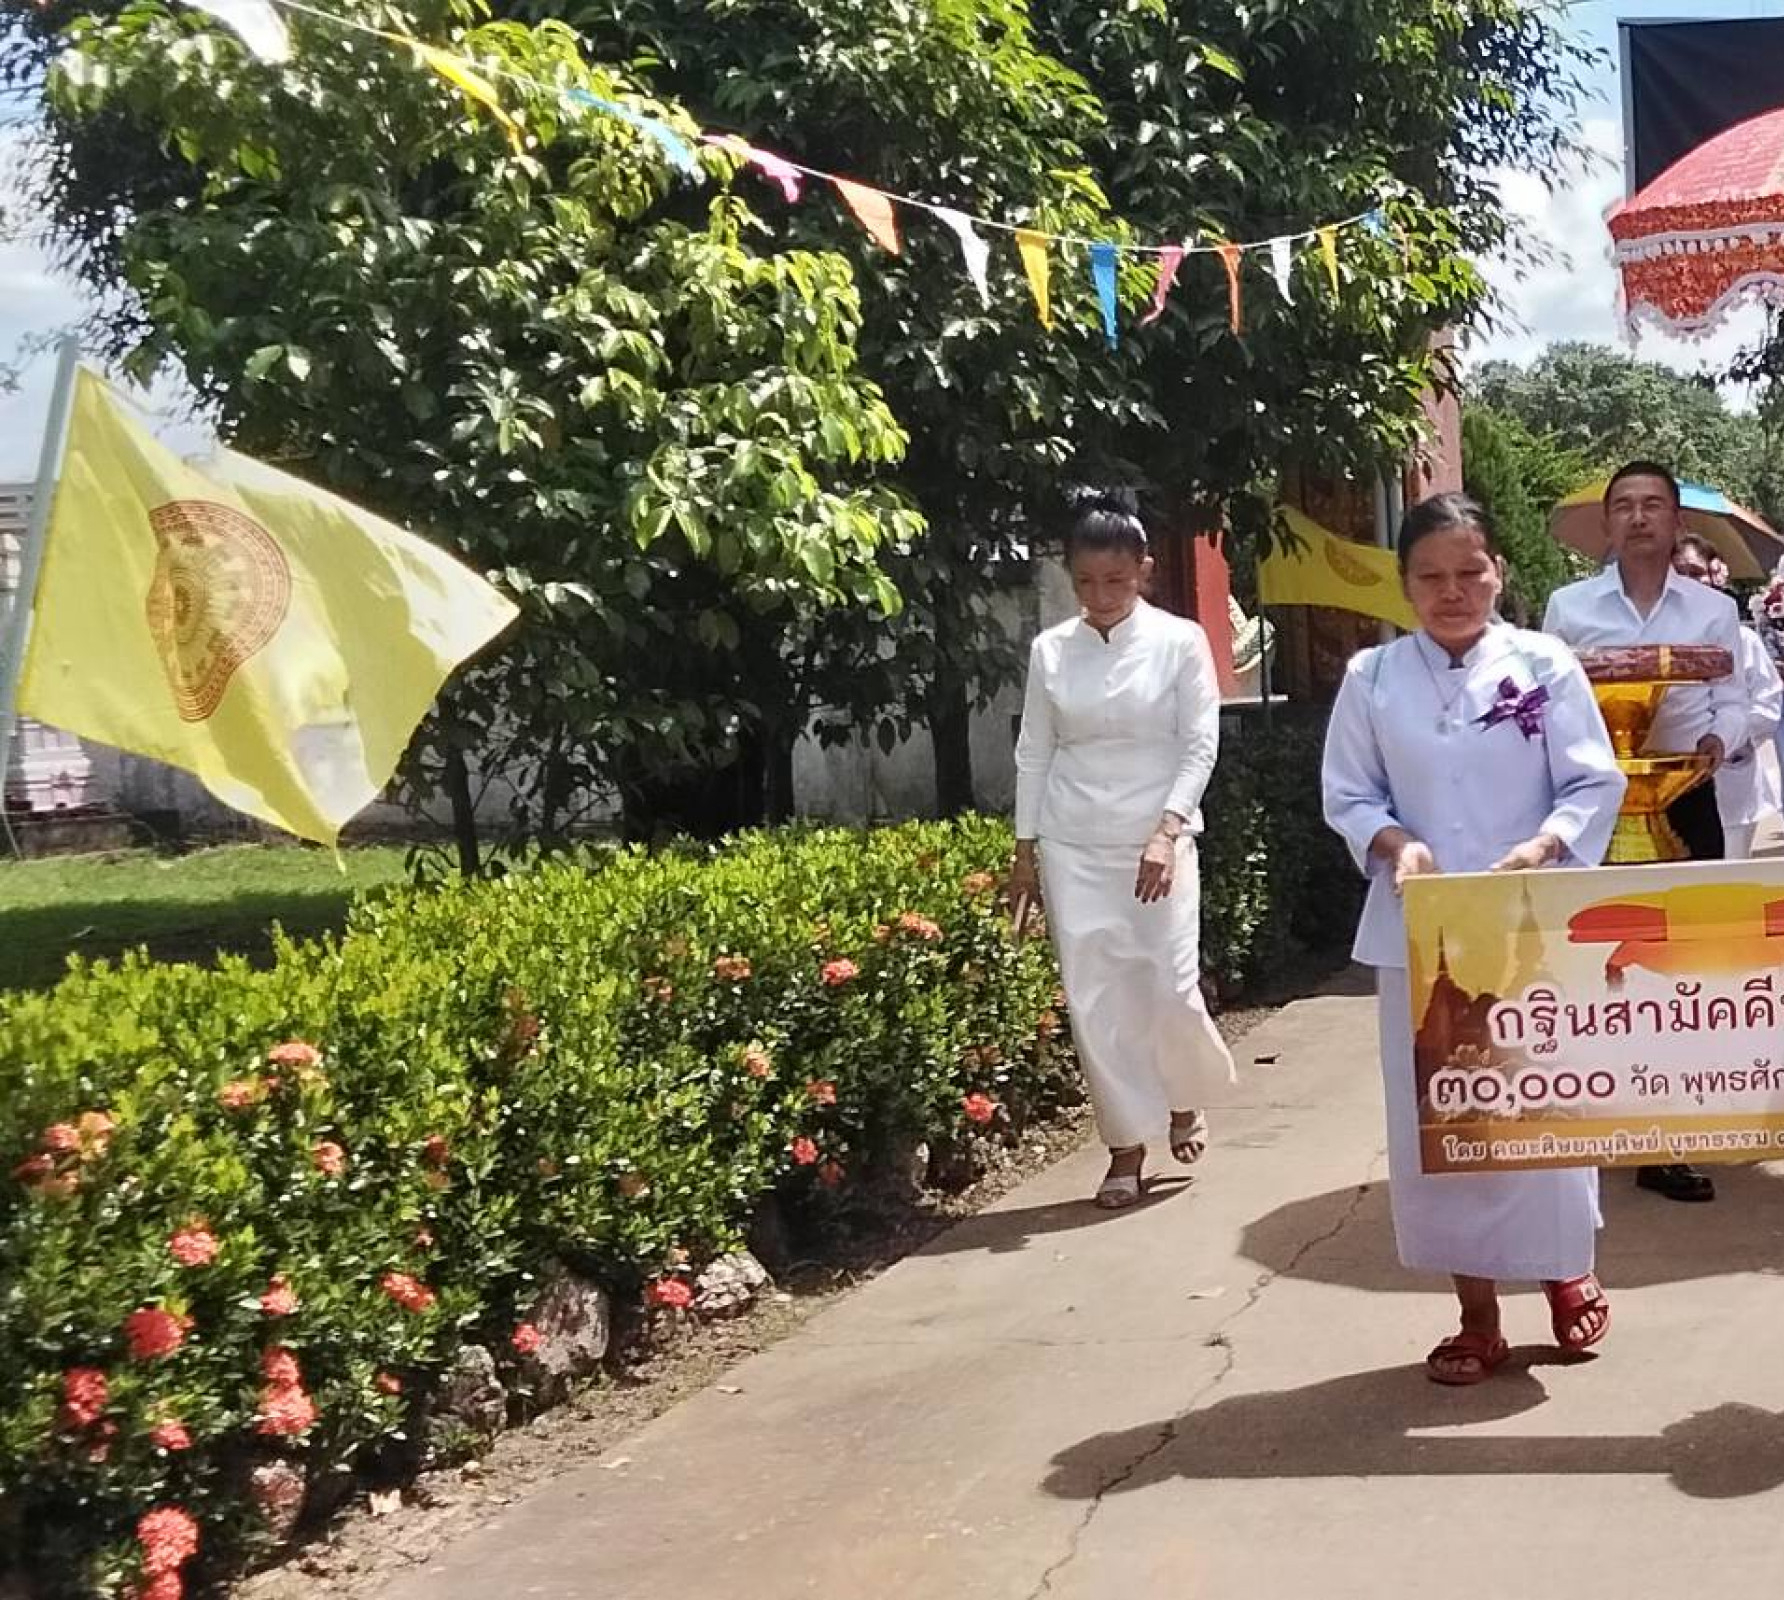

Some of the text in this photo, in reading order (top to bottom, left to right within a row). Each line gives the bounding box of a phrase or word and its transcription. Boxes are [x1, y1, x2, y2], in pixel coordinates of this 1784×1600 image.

[1436, 1070, 1616, 1108] ๓๐,๐๐๐
[1630, 1063, 1670, 1097] วัด
[1444, 1136, 1485, 1160] โดย
[1493, 1128, 1660, 1161] คณะศิษยานุศิษย์
[1667, 1130, 1768, 1158] บูชาธรรม
